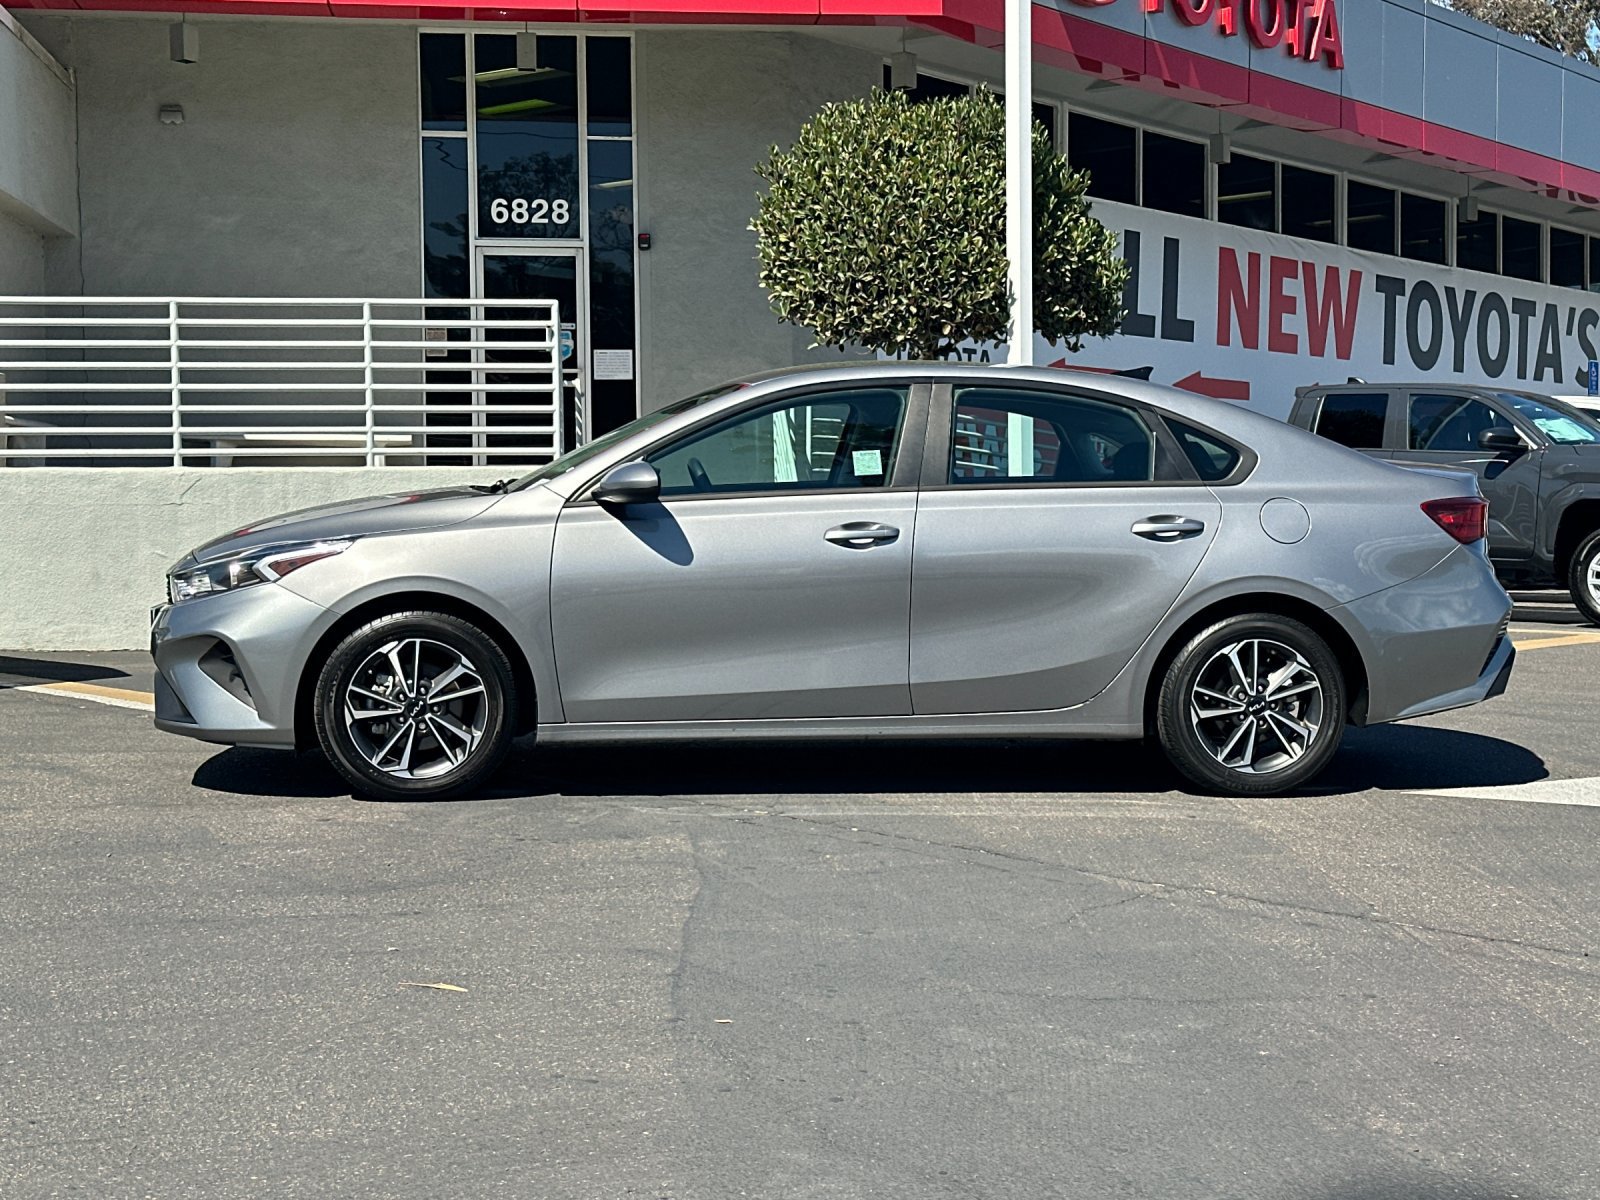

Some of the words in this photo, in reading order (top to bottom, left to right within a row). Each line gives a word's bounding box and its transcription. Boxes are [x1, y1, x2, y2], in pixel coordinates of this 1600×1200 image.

[1142, 0, 1344, 69] YOTA
[491, 198, 569, 224] 6828
[1121, 229, 1195, 342] LL
[1216, 246, 1363, 360] NEW
[1375, 274, 1600, 389] TOYOTA'S
